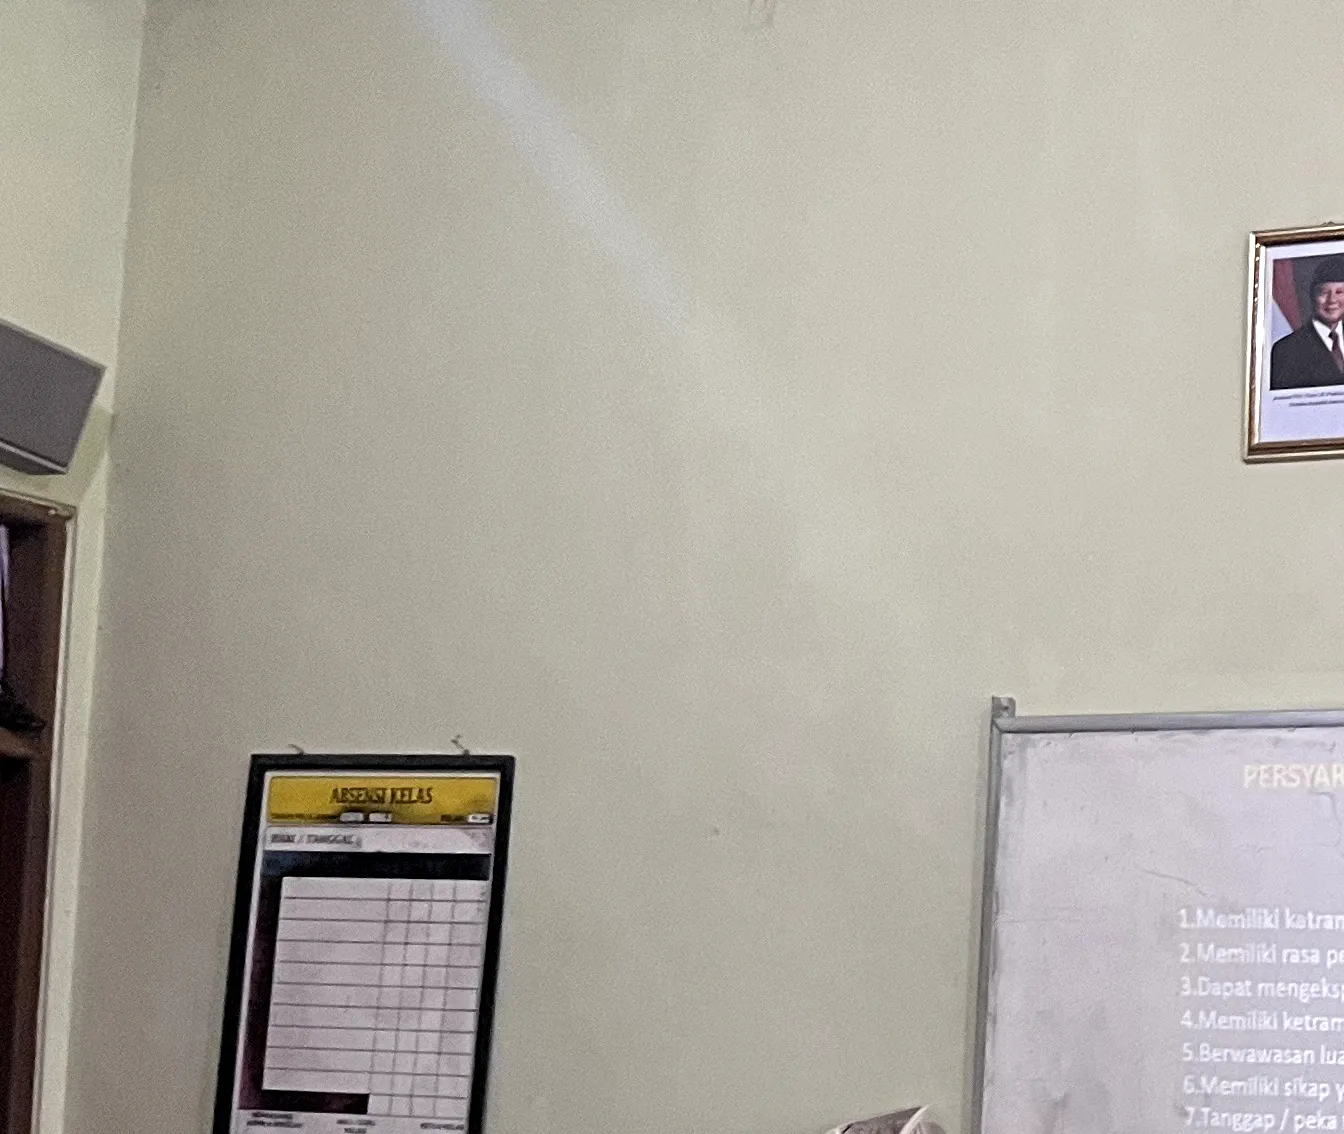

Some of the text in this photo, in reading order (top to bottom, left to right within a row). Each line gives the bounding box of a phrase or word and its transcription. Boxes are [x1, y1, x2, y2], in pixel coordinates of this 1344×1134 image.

[1281, 947, 1320, 965] rasa
[1182, 1042, 1315, 1065] 5.Berwawasan
[1284, 1077, 1330, 1101] sikap
[1278, 1107, 1290, 1132] /
[1293, 1111, 1338, 1134] peka
